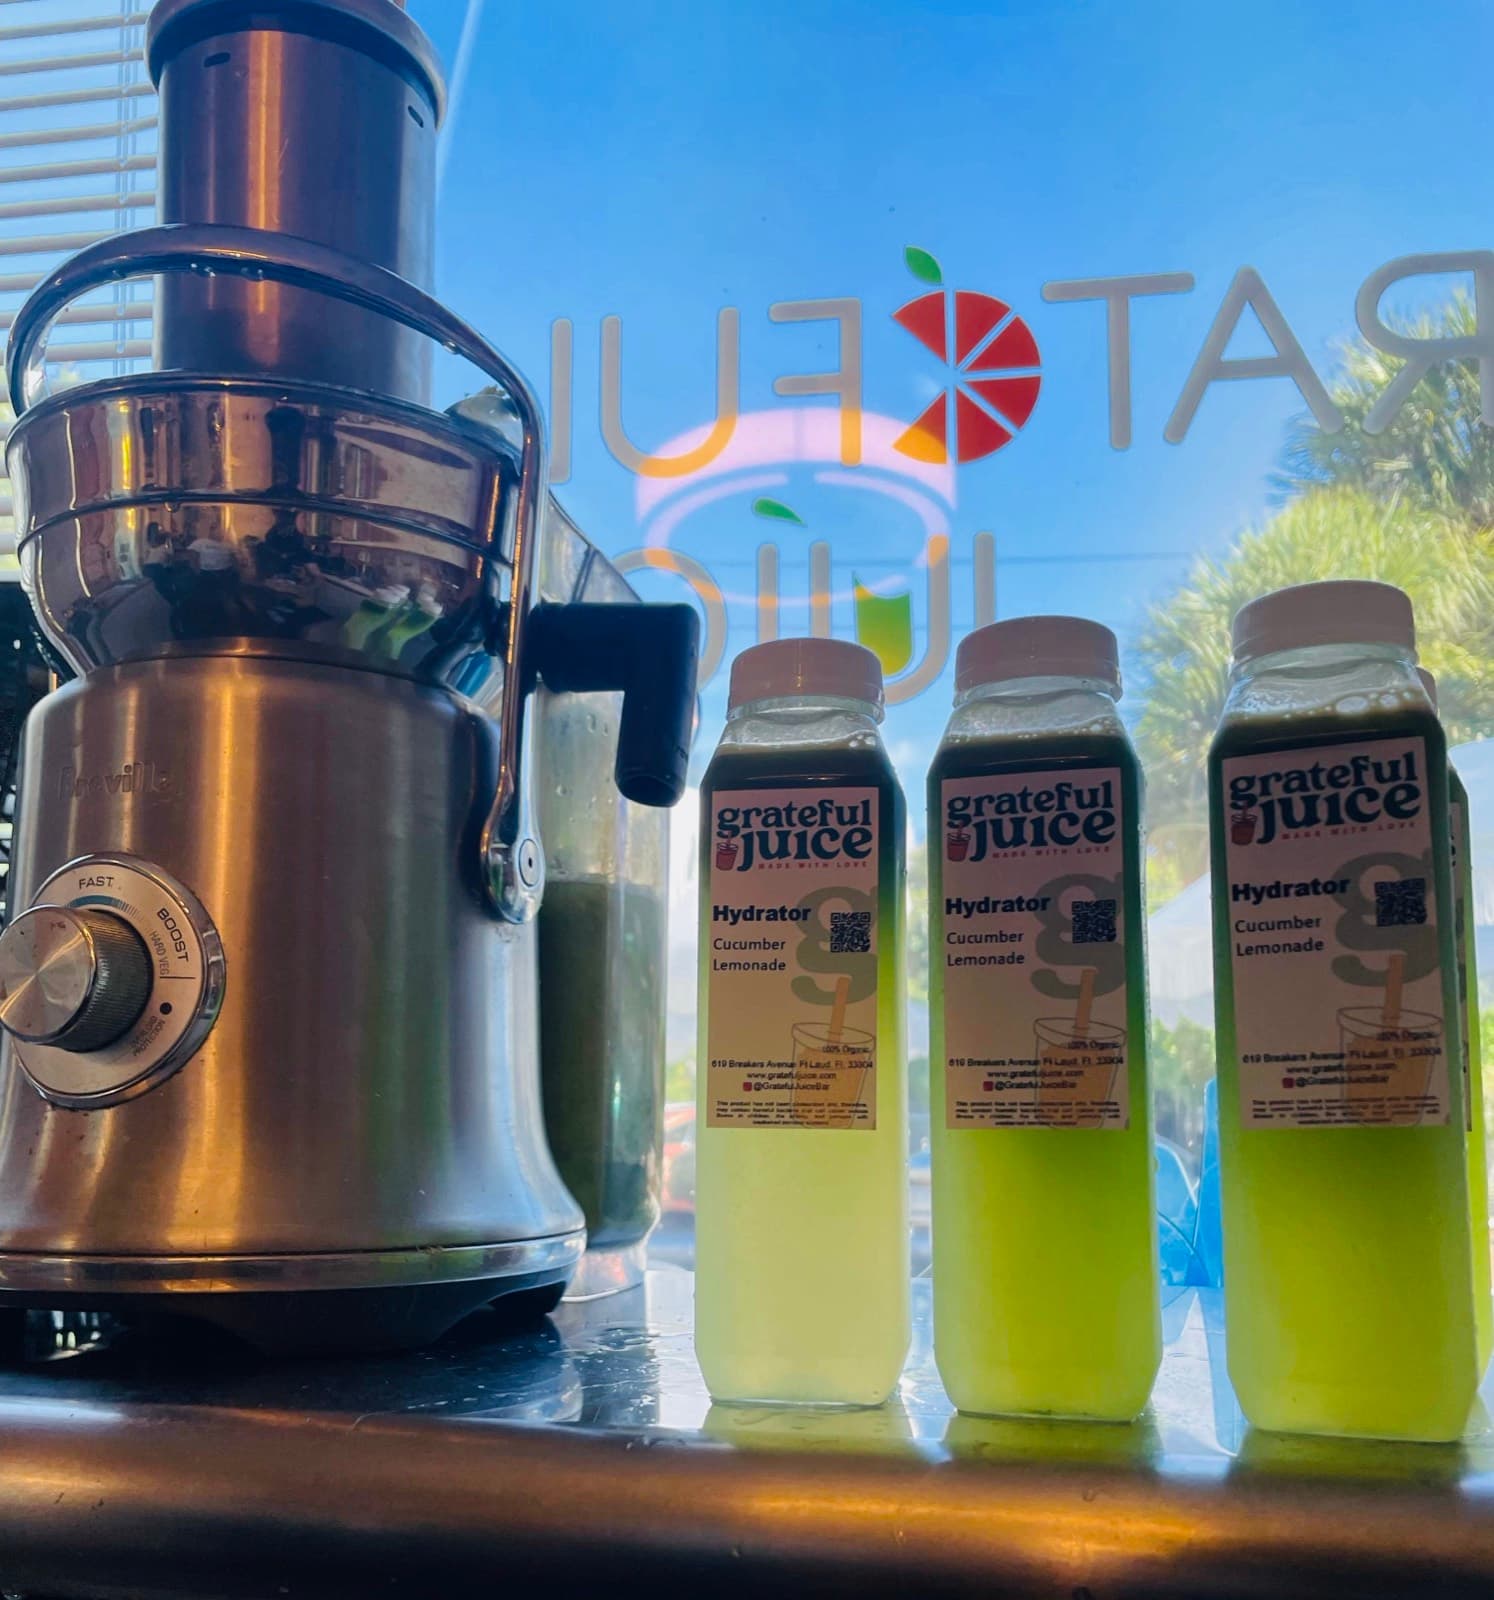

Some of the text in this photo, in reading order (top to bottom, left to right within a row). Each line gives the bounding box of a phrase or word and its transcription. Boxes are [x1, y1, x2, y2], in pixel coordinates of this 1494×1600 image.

[1229, 751, 1418, 811] grateful
[946, 780, 1115, 829] grateful
[1256, 783, 1421, 844] juice
[717, 799, 873, 839] grateful
[969, 810, 1116, 862] juice
[736, 827, 873, 872] juice
[758, 862, 790, 870] MADE
[836, 860, 868, 869] LOVE
[78, 876, 115, 890] FAST
[1231, 878, 1351, 905] Hydrator
[712, 905, 812, 926] Hydrator
[945, 895, 1052, 919] Hydrator
[157, 907, 189, 962] BOOST
[1234, 915, 1322, 934] Cucumber
[149, 930, 167, 957] HARD
[713, 937, 786, 951] Cucumber
[946, 930, 1024, 945] Cucumber
[1236, 937, 1324, 957] Lemonade
[713, 958, 786, 972] Lemonade
[946, 951, 1025, 967] Lemonade
[711, 1059, 727, 1068] 619
